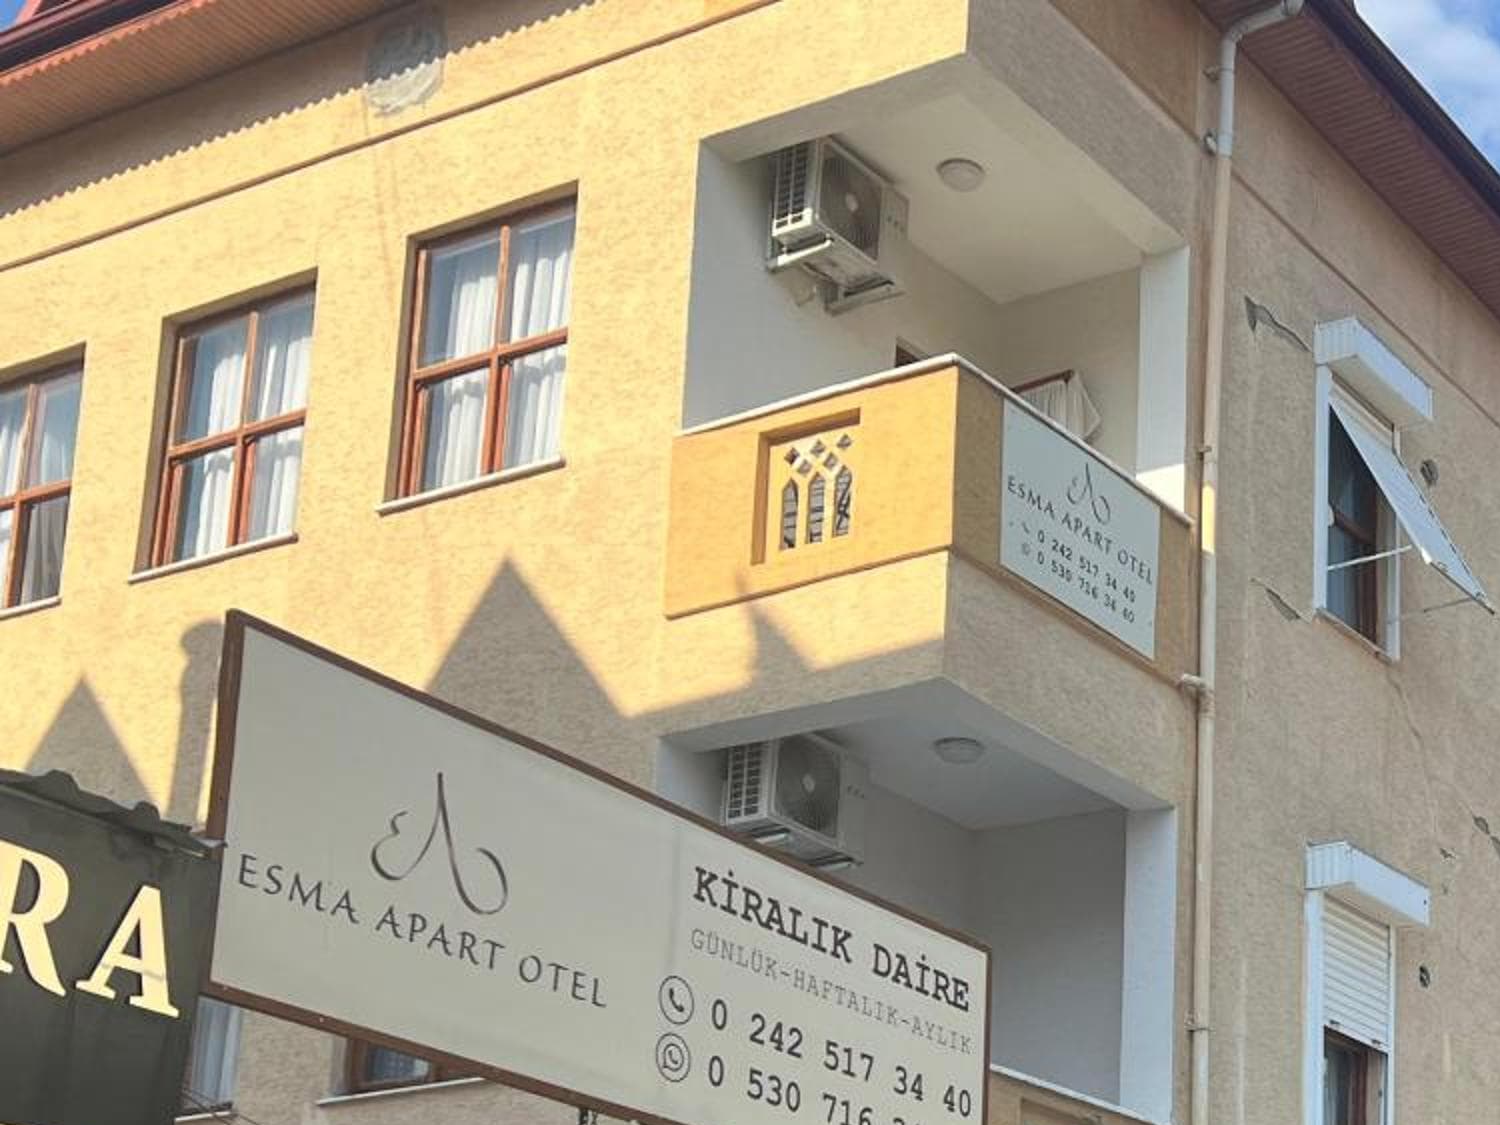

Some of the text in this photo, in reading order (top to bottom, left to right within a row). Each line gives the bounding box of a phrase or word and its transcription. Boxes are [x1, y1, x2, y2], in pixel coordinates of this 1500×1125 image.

[1008, 475, 1152, 585] ESMA APART OTEL
[1037, 530, 1045, 543] 0
[1052, 539, 1073, 561] 242
[1079, 556, 1099, 577] 517
[1037, 551, 1045, 565] 0
[239, 853, 607, 1007] ESMA APART OTEL
[693, 866, 969, 1012] KİRALIK DAİRE
[691, 928, 972, 1055] GÜNLÜK-HAFTALIK-AYLIK
[708, 1055, 725, 1087] 0
[746, 1067, 801, 1113] 530
[711, 999, 972, 1117] 0 242 517 34 40
